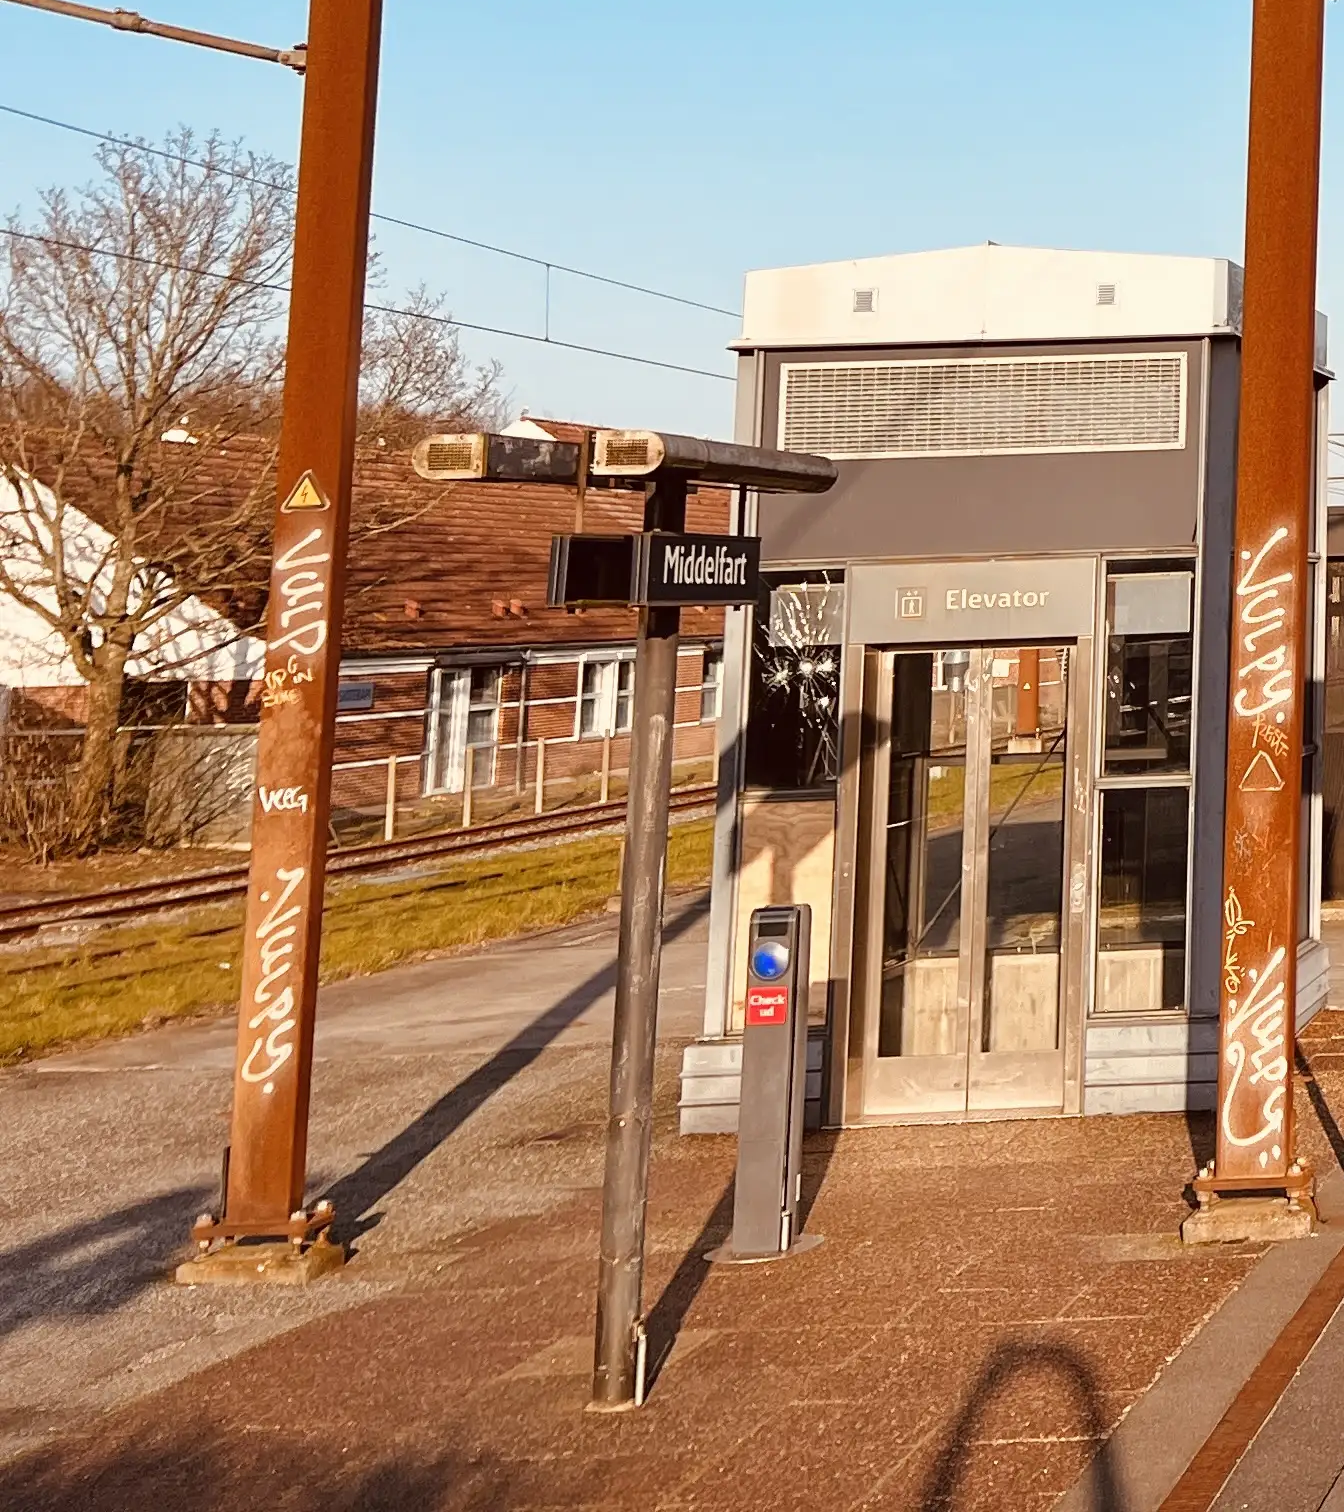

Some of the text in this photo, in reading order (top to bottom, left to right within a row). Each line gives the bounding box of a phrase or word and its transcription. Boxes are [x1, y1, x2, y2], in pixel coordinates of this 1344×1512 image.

[662, 544, 748, 586] Middelfart
[946, 588, 1050, 611] Elevator
[750, 993, 786, 1006] Check
